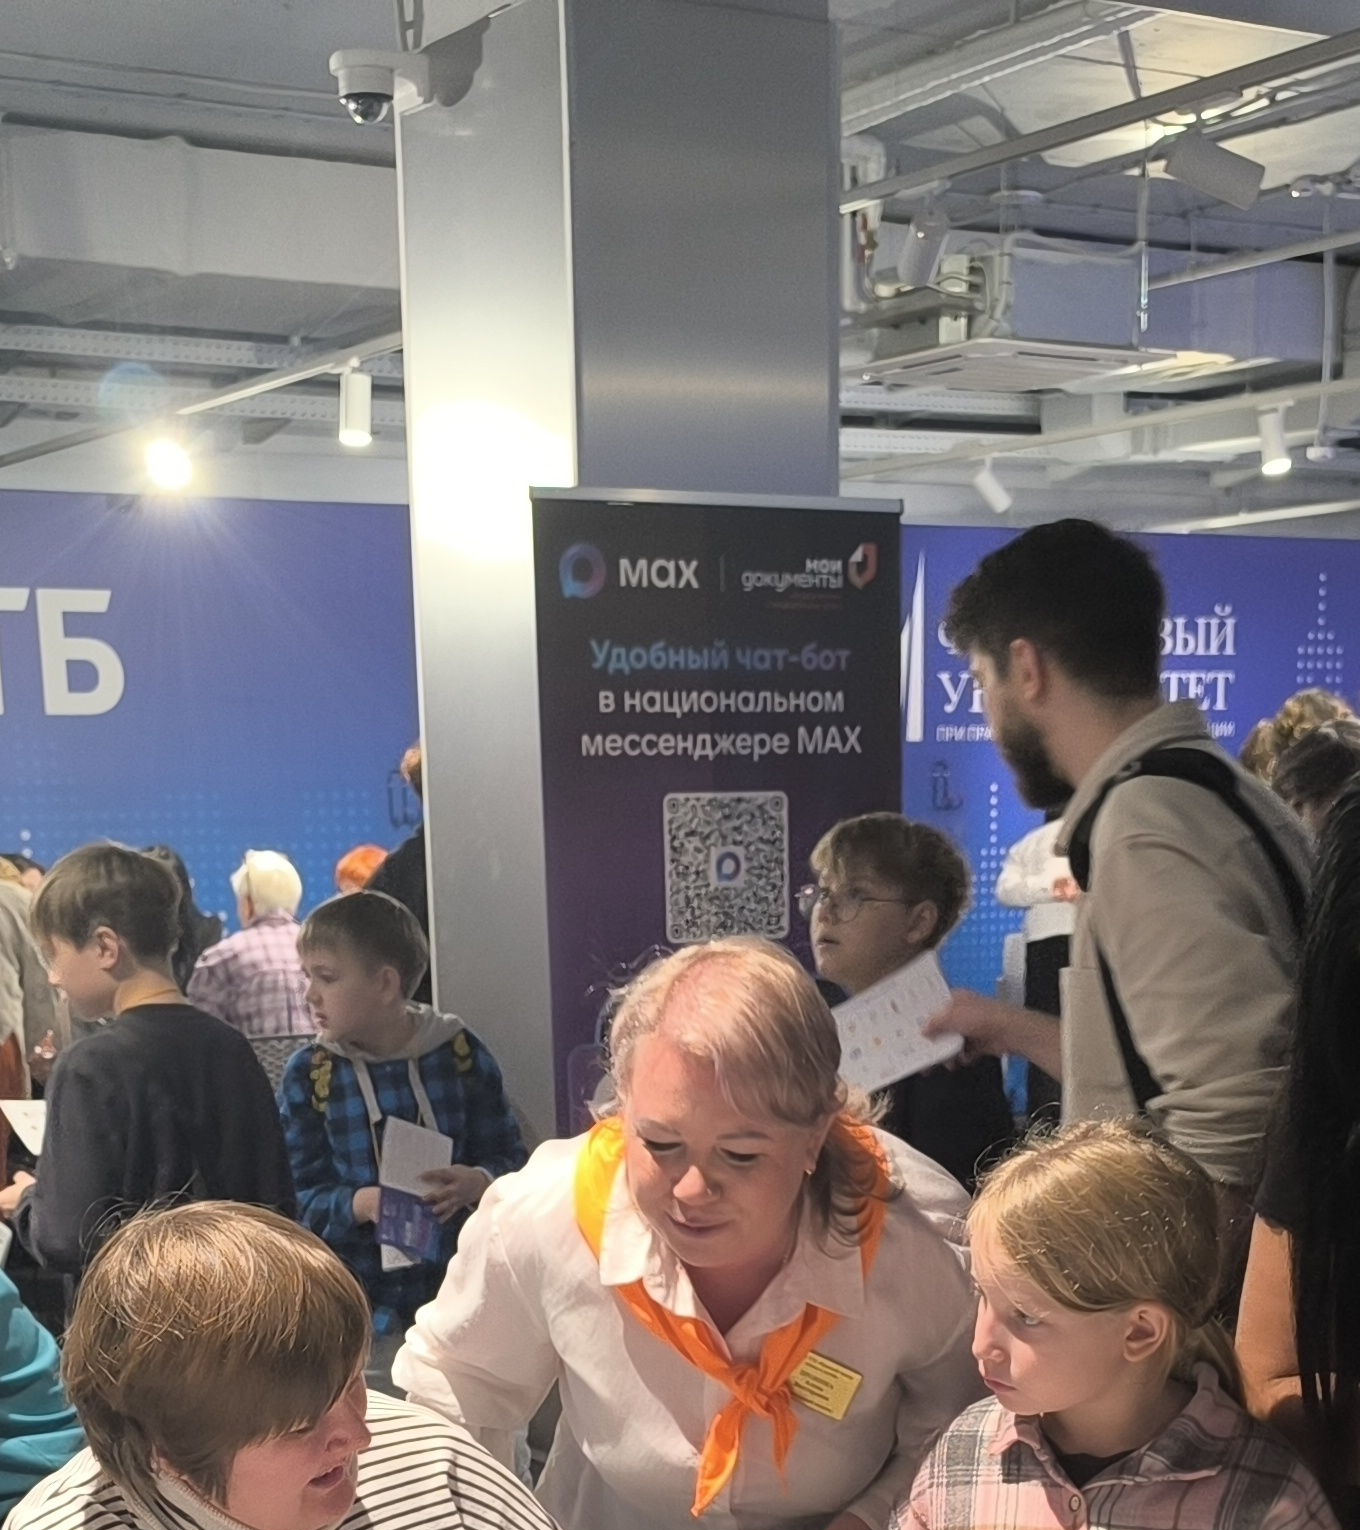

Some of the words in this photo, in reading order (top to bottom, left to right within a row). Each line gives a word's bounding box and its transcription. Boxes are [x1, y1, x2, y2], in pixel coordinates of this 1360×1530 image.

[590, 639, 728, 675] Удобный
[735, 642, 851, 672] чат-бот
[598, 690, 616, 712] в
[625, 689, 845, 718] национальном
[582, 732, 790, 761] мессенджере
